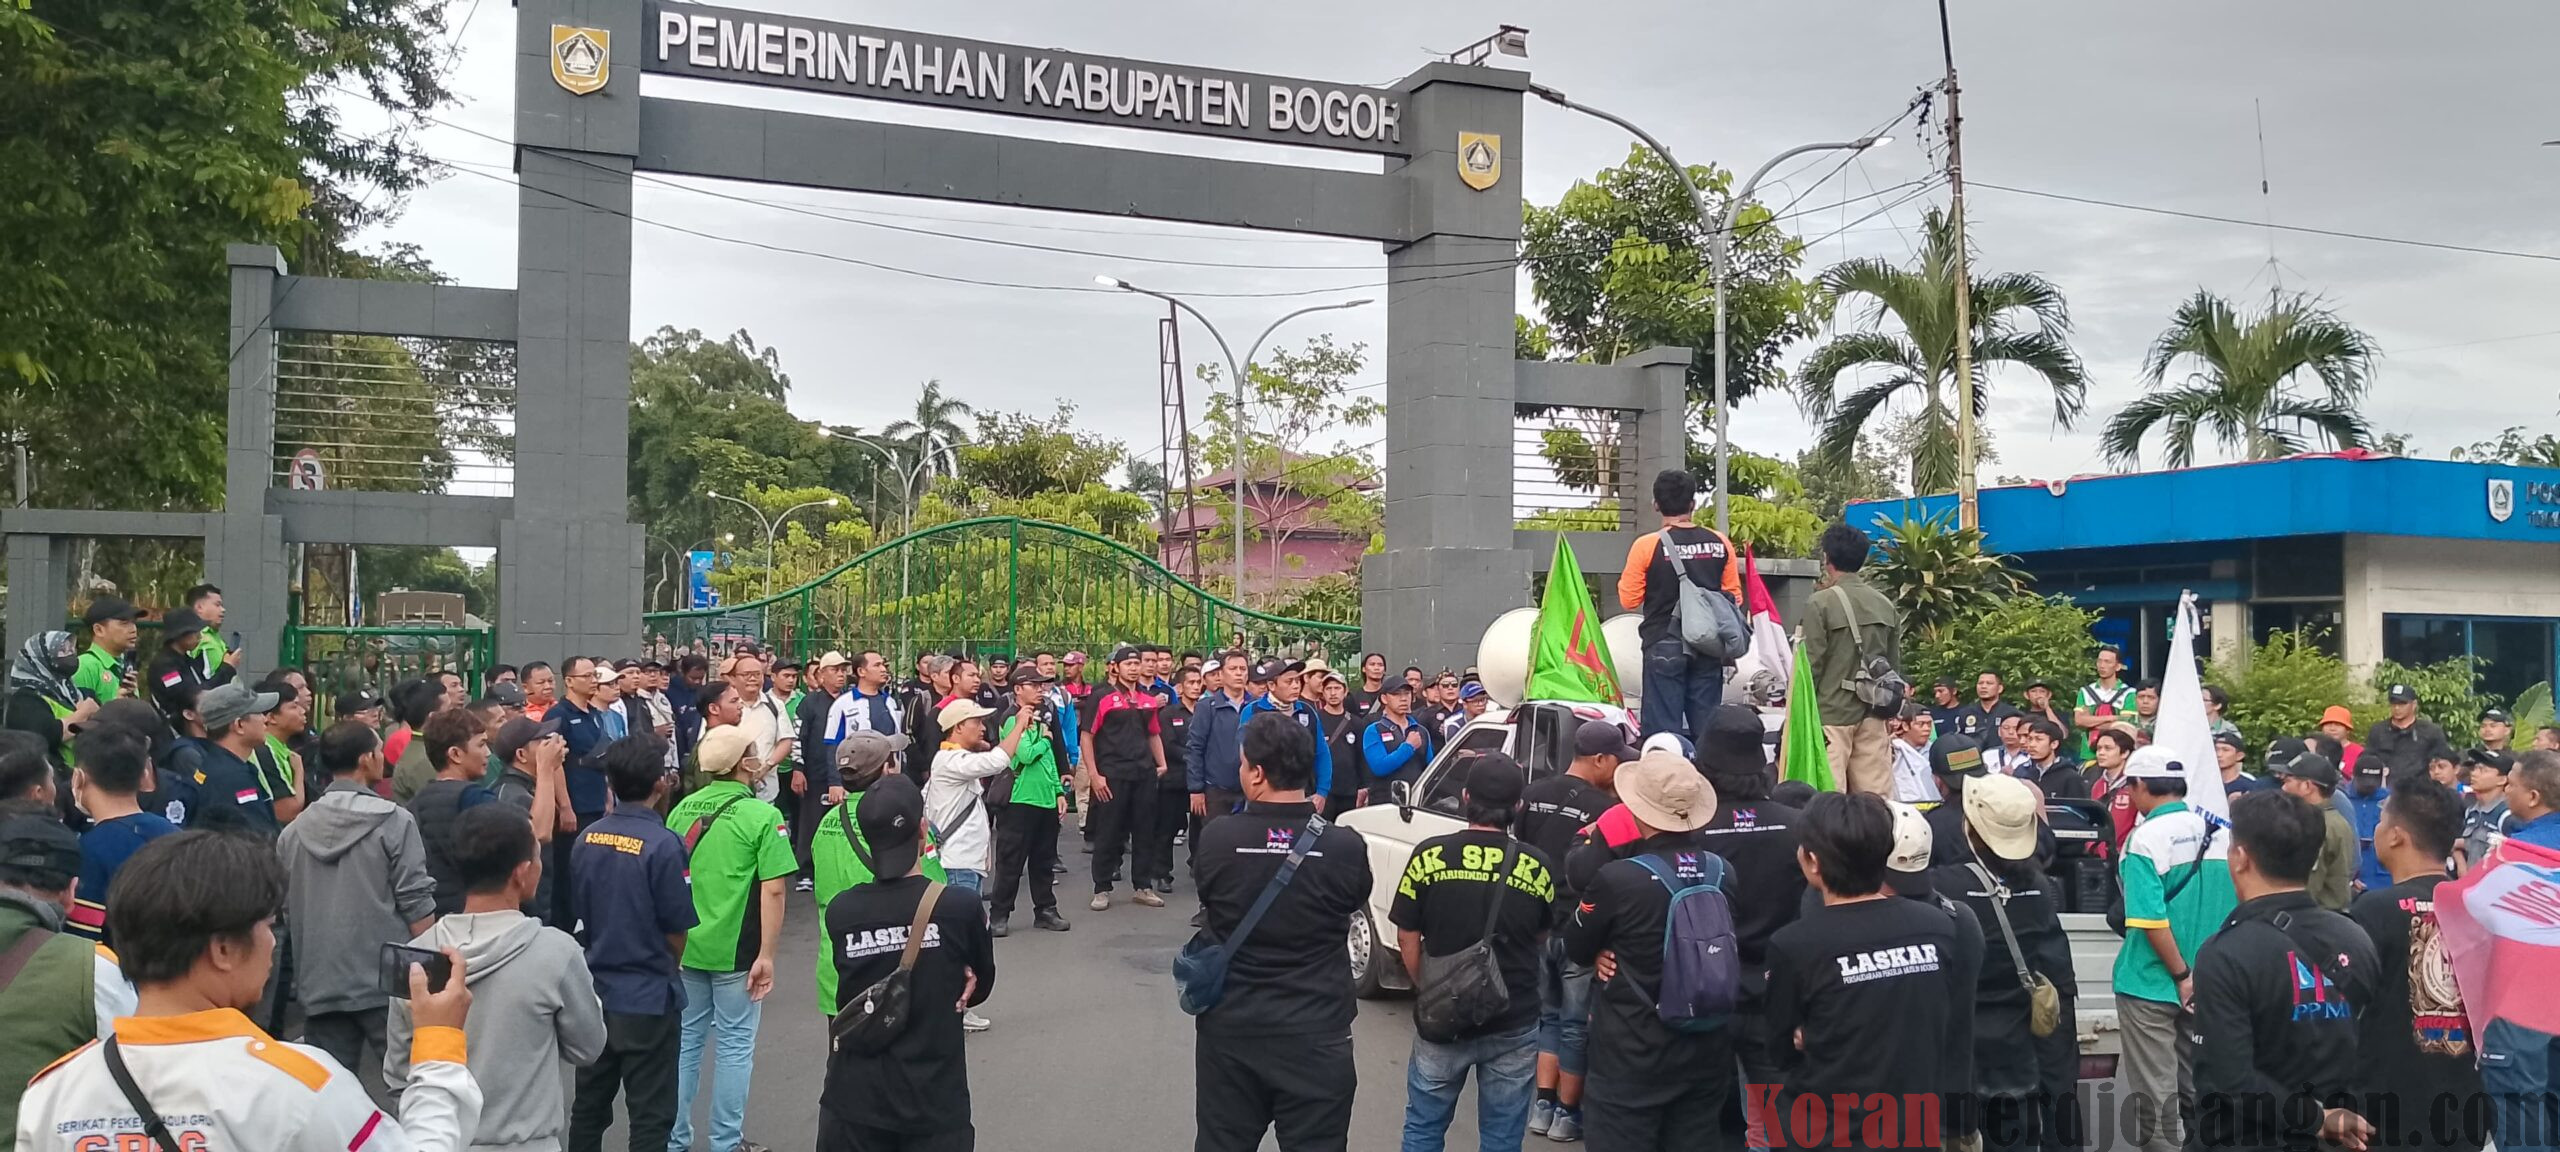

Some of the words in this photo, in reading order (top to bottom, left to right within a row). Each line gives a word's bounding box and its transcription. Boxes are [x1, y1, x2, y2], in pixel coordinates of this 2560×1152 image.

[658, 10, 1006, 101] PEMERINTAHAN
[1023, 56, 1250, 128] KABUPATEN
[1268, 85, 1400, 142] BOGOR
[1399, 845, 1447, 900] PUK
[1462, 844, 1504, 871] SP
[1434, 869, 1489, 882] PARISINDO
[1836, 944, 1939, 976] LASKAR
[57, 1118, 105, 1133] SERIKAT
[110, 1117, 145, 1129] PEKE
